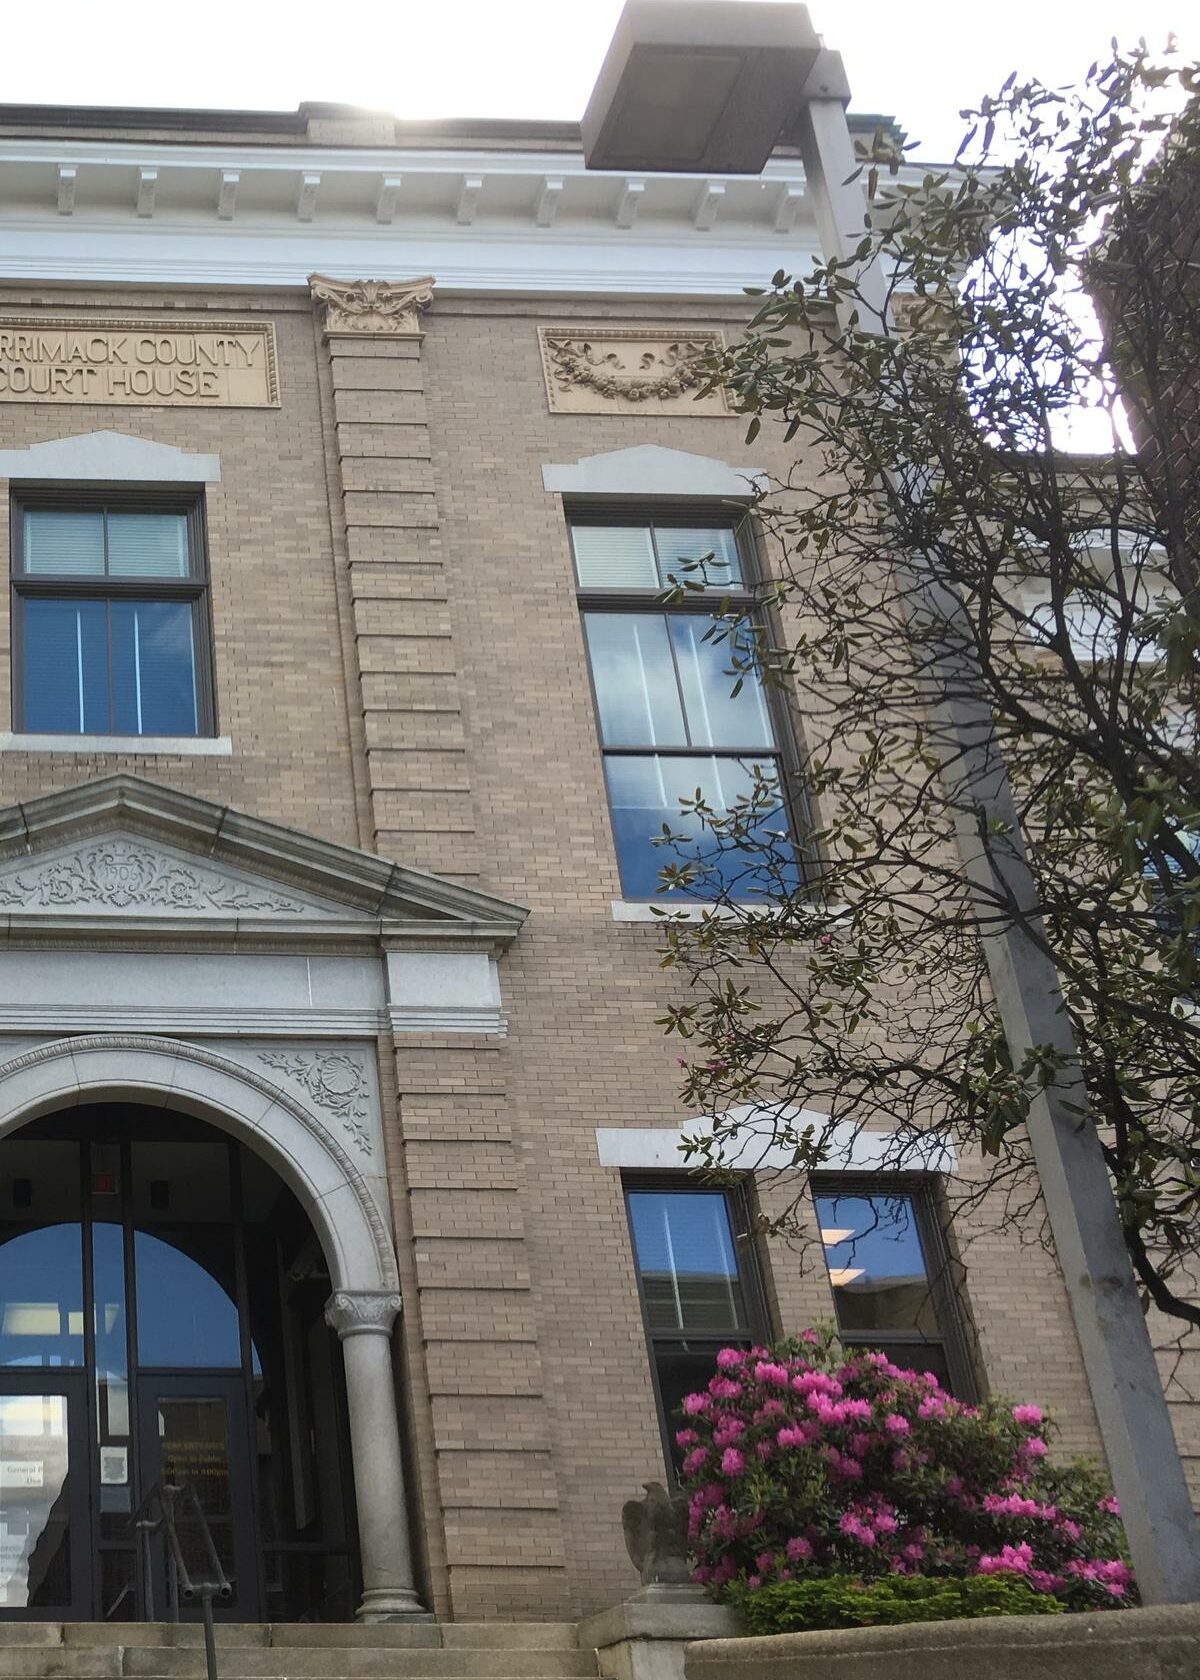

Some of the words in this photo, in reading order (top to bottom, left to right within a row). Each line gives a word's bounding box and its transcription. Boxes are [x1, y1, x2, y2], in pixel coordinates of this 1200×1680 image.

[135, 338, 260, 367] COUNTY
[108, 368, 220, 397] HOUSE
[105, 865, 138, 881] 1906
